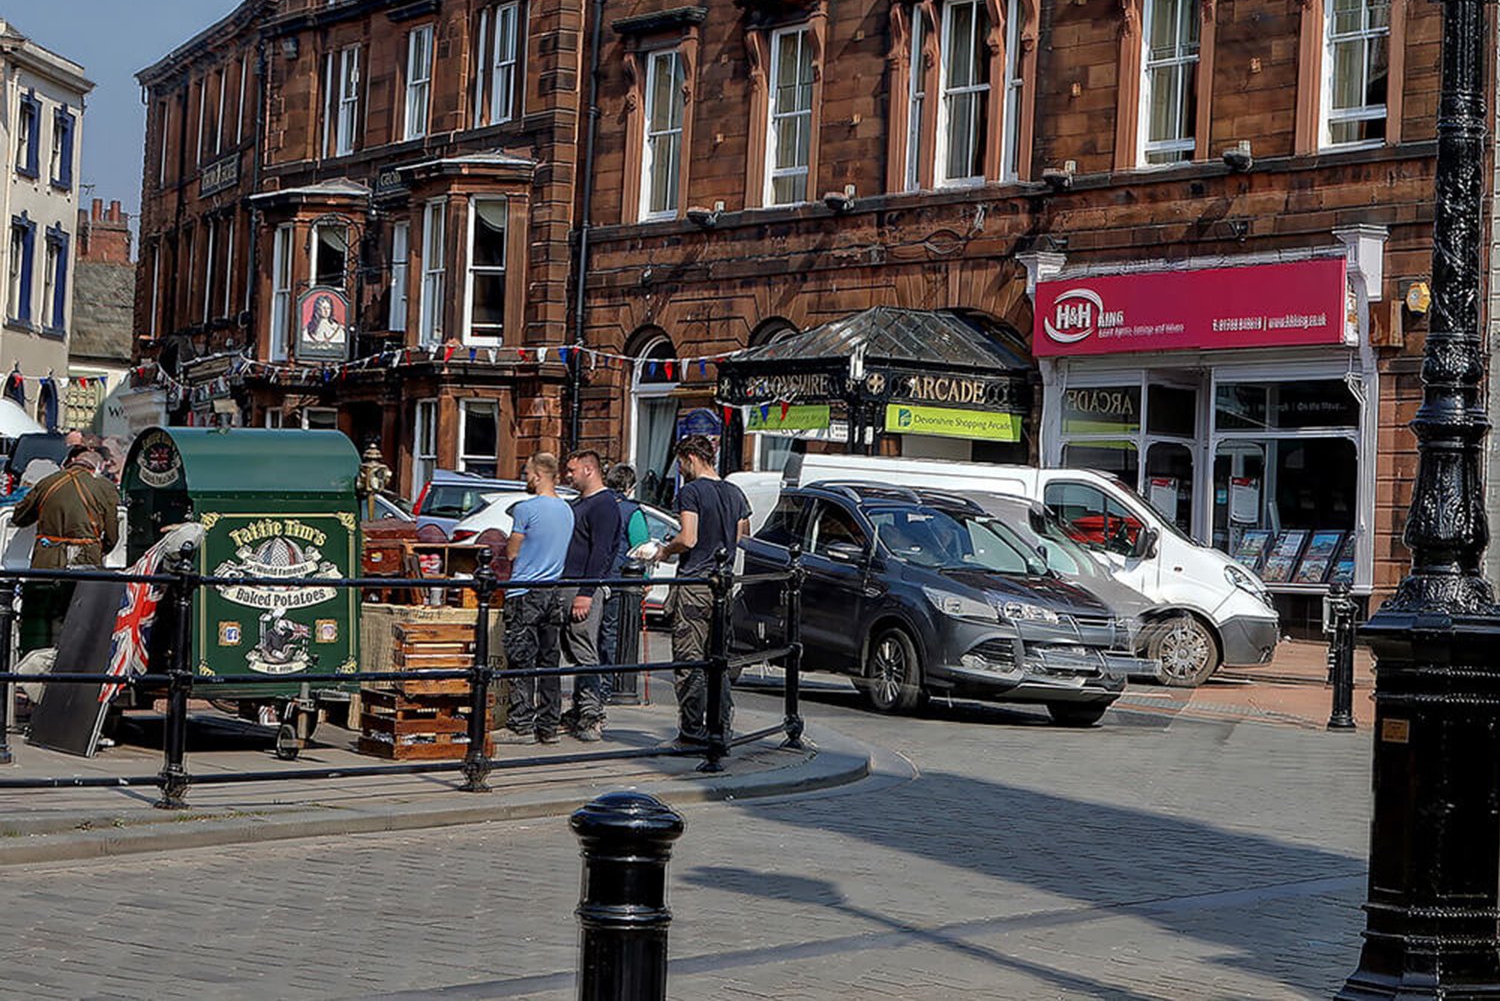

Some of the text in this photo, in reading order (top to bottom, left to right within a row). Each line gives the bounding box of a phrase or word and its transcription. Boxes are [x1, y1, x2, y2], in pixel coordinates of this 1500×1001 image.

[1056, 302, 1091, 330] H&H
[909, 376, 986, 404] ARCADE
[914, 414, 954, 427] Devonshire
[955, 417, 985, 430] Shopping
[228, 518, 327, 547] Tattie Tim's
[236, 587, 327, 607] Baked Potatoes
